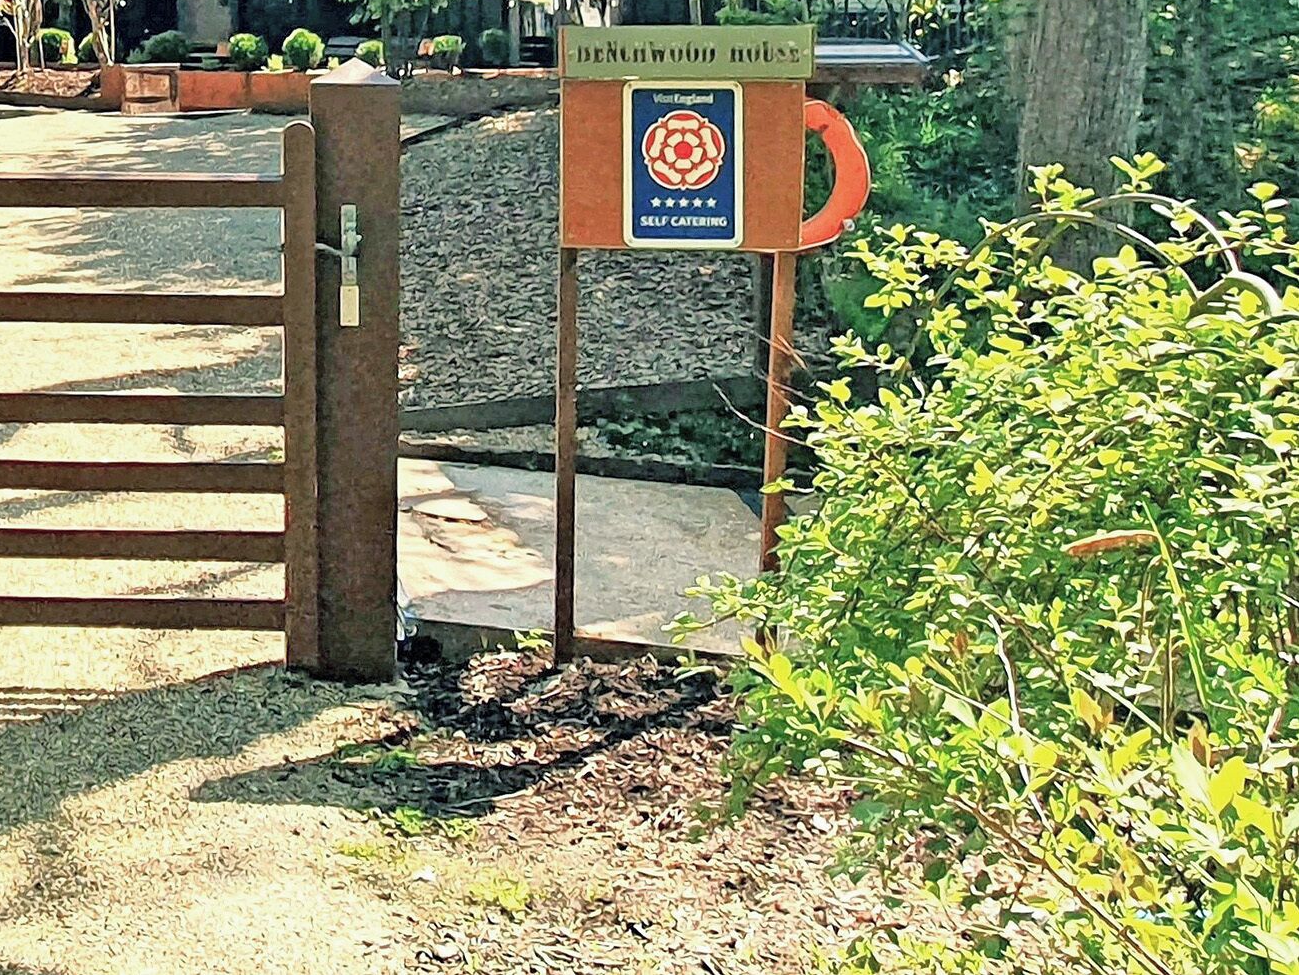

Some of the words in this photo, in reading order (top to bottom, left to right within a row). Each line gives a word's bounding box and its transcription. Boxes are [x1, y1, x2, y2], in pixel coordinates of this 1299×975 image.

[729, 41, 800, 63] HOUSE
[639, 215, 669, 227] SELF
[670, 215, 728, 228] CATERING
